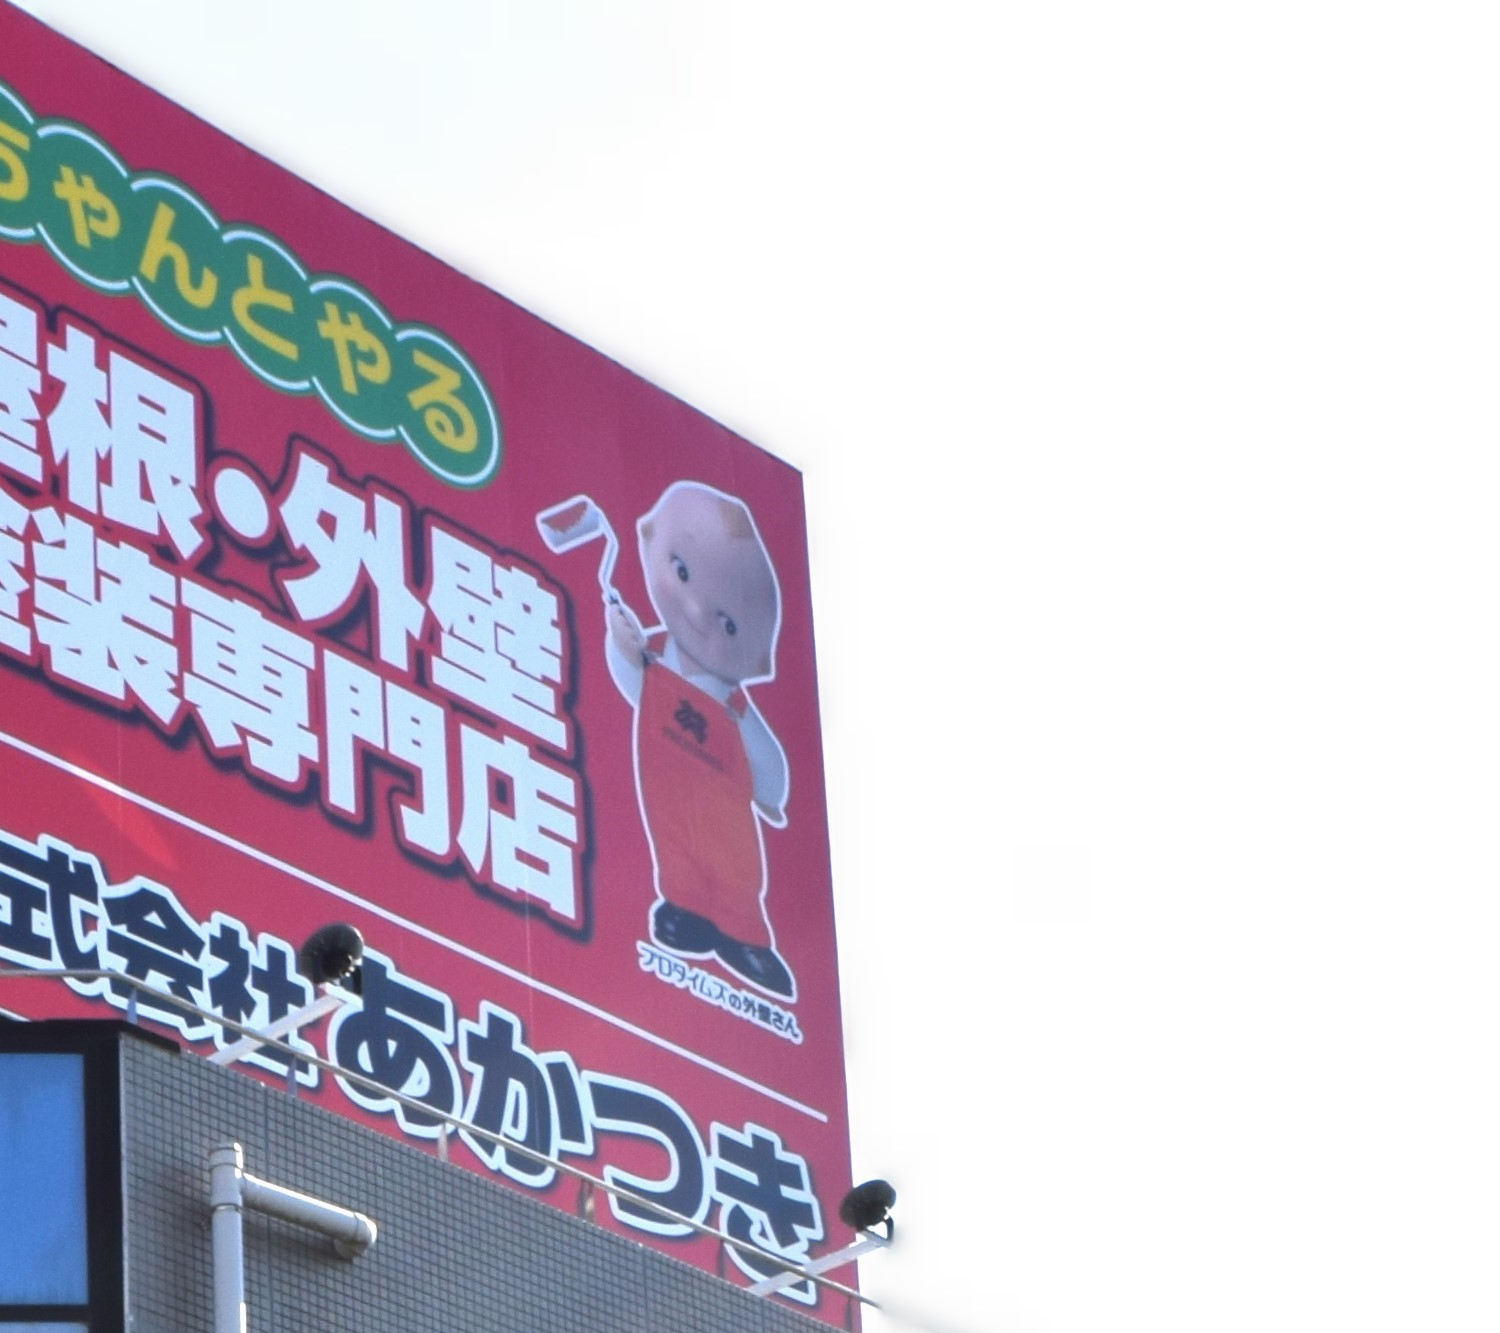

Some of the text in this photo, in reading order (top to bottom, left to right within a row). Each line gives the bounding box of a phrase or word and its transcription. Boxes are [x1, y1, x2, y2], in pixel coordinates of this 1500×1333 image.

[640, 942, 803, 1042] プロタイムズの外壁さん
